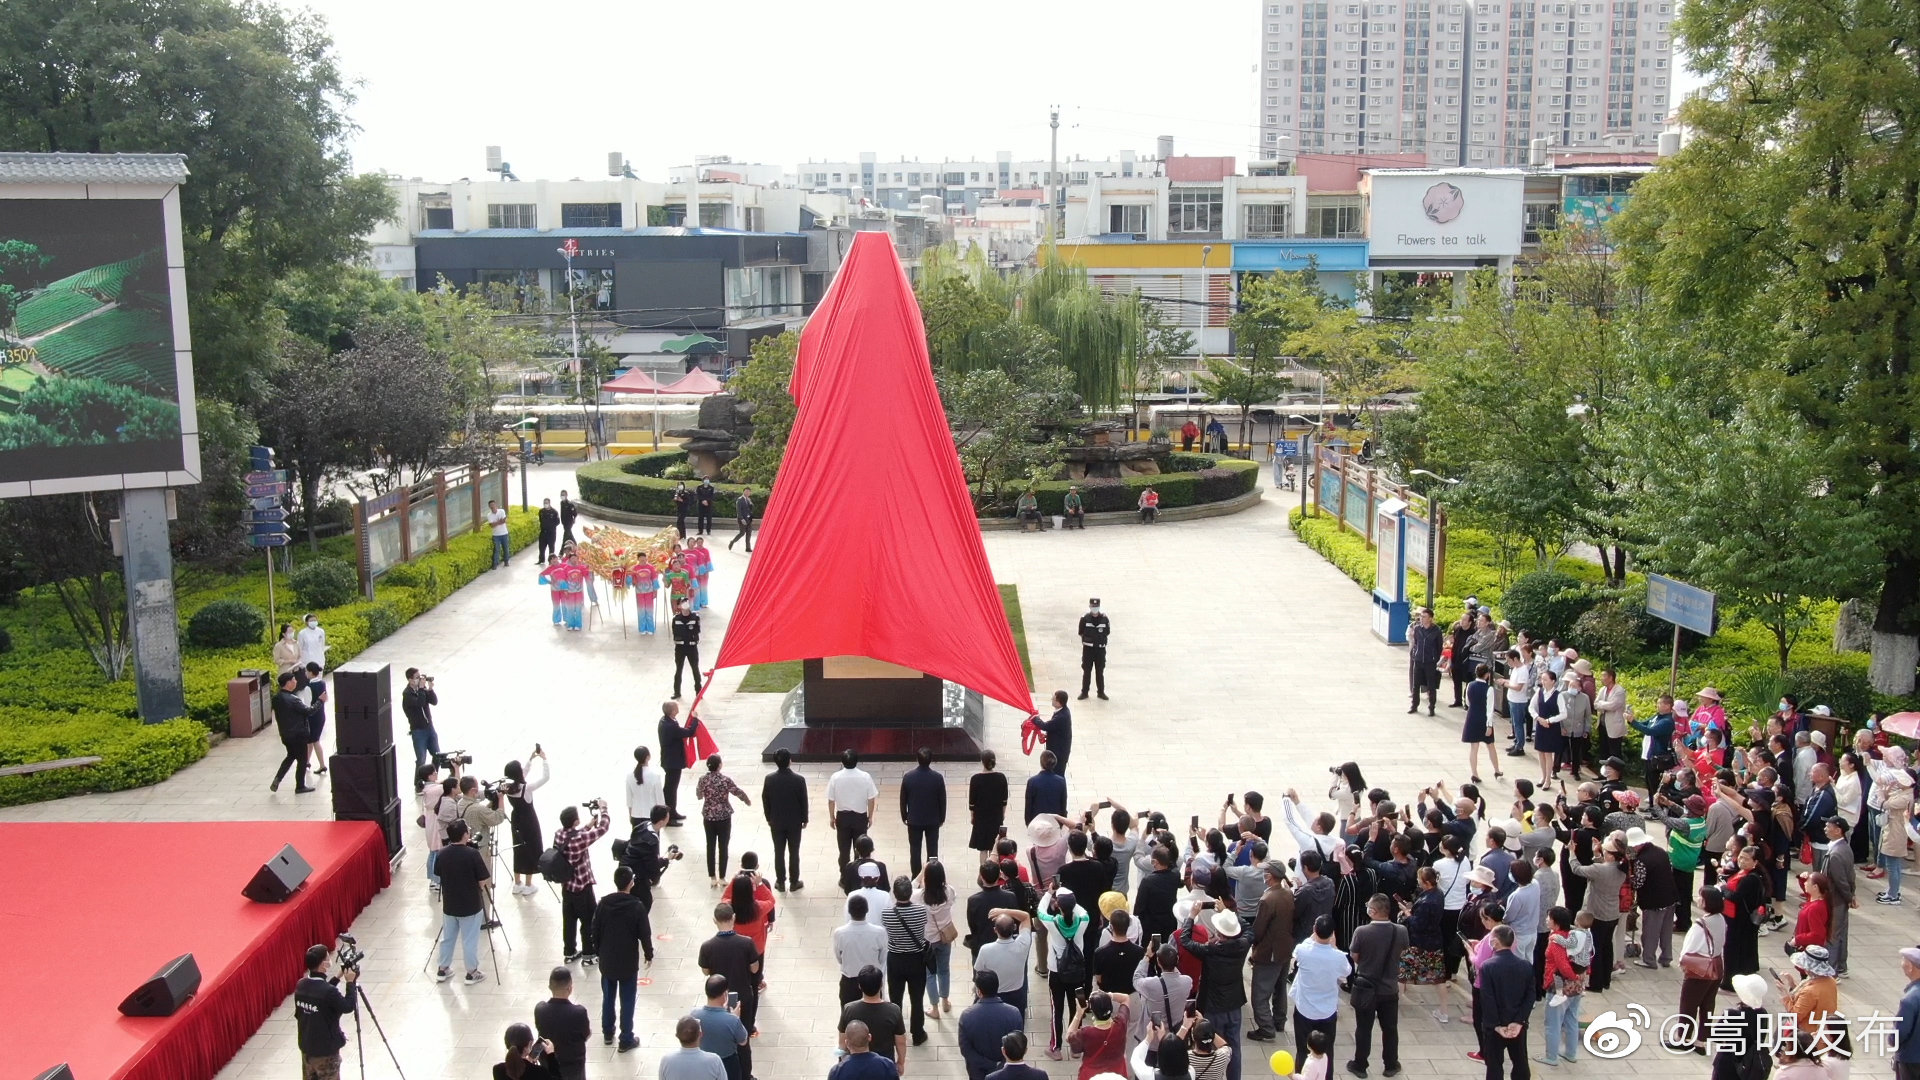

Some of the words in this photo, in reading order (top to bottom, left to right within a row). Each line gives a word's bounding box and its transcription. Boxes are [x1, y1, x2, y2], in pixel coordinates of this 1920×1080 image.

[1397, 233, 1436, 246] Flowers
[1441, 235, 1459, 246] tea
[1466, 233, 1487, 246] talk
[579, 249, 615, 257] TRIES
